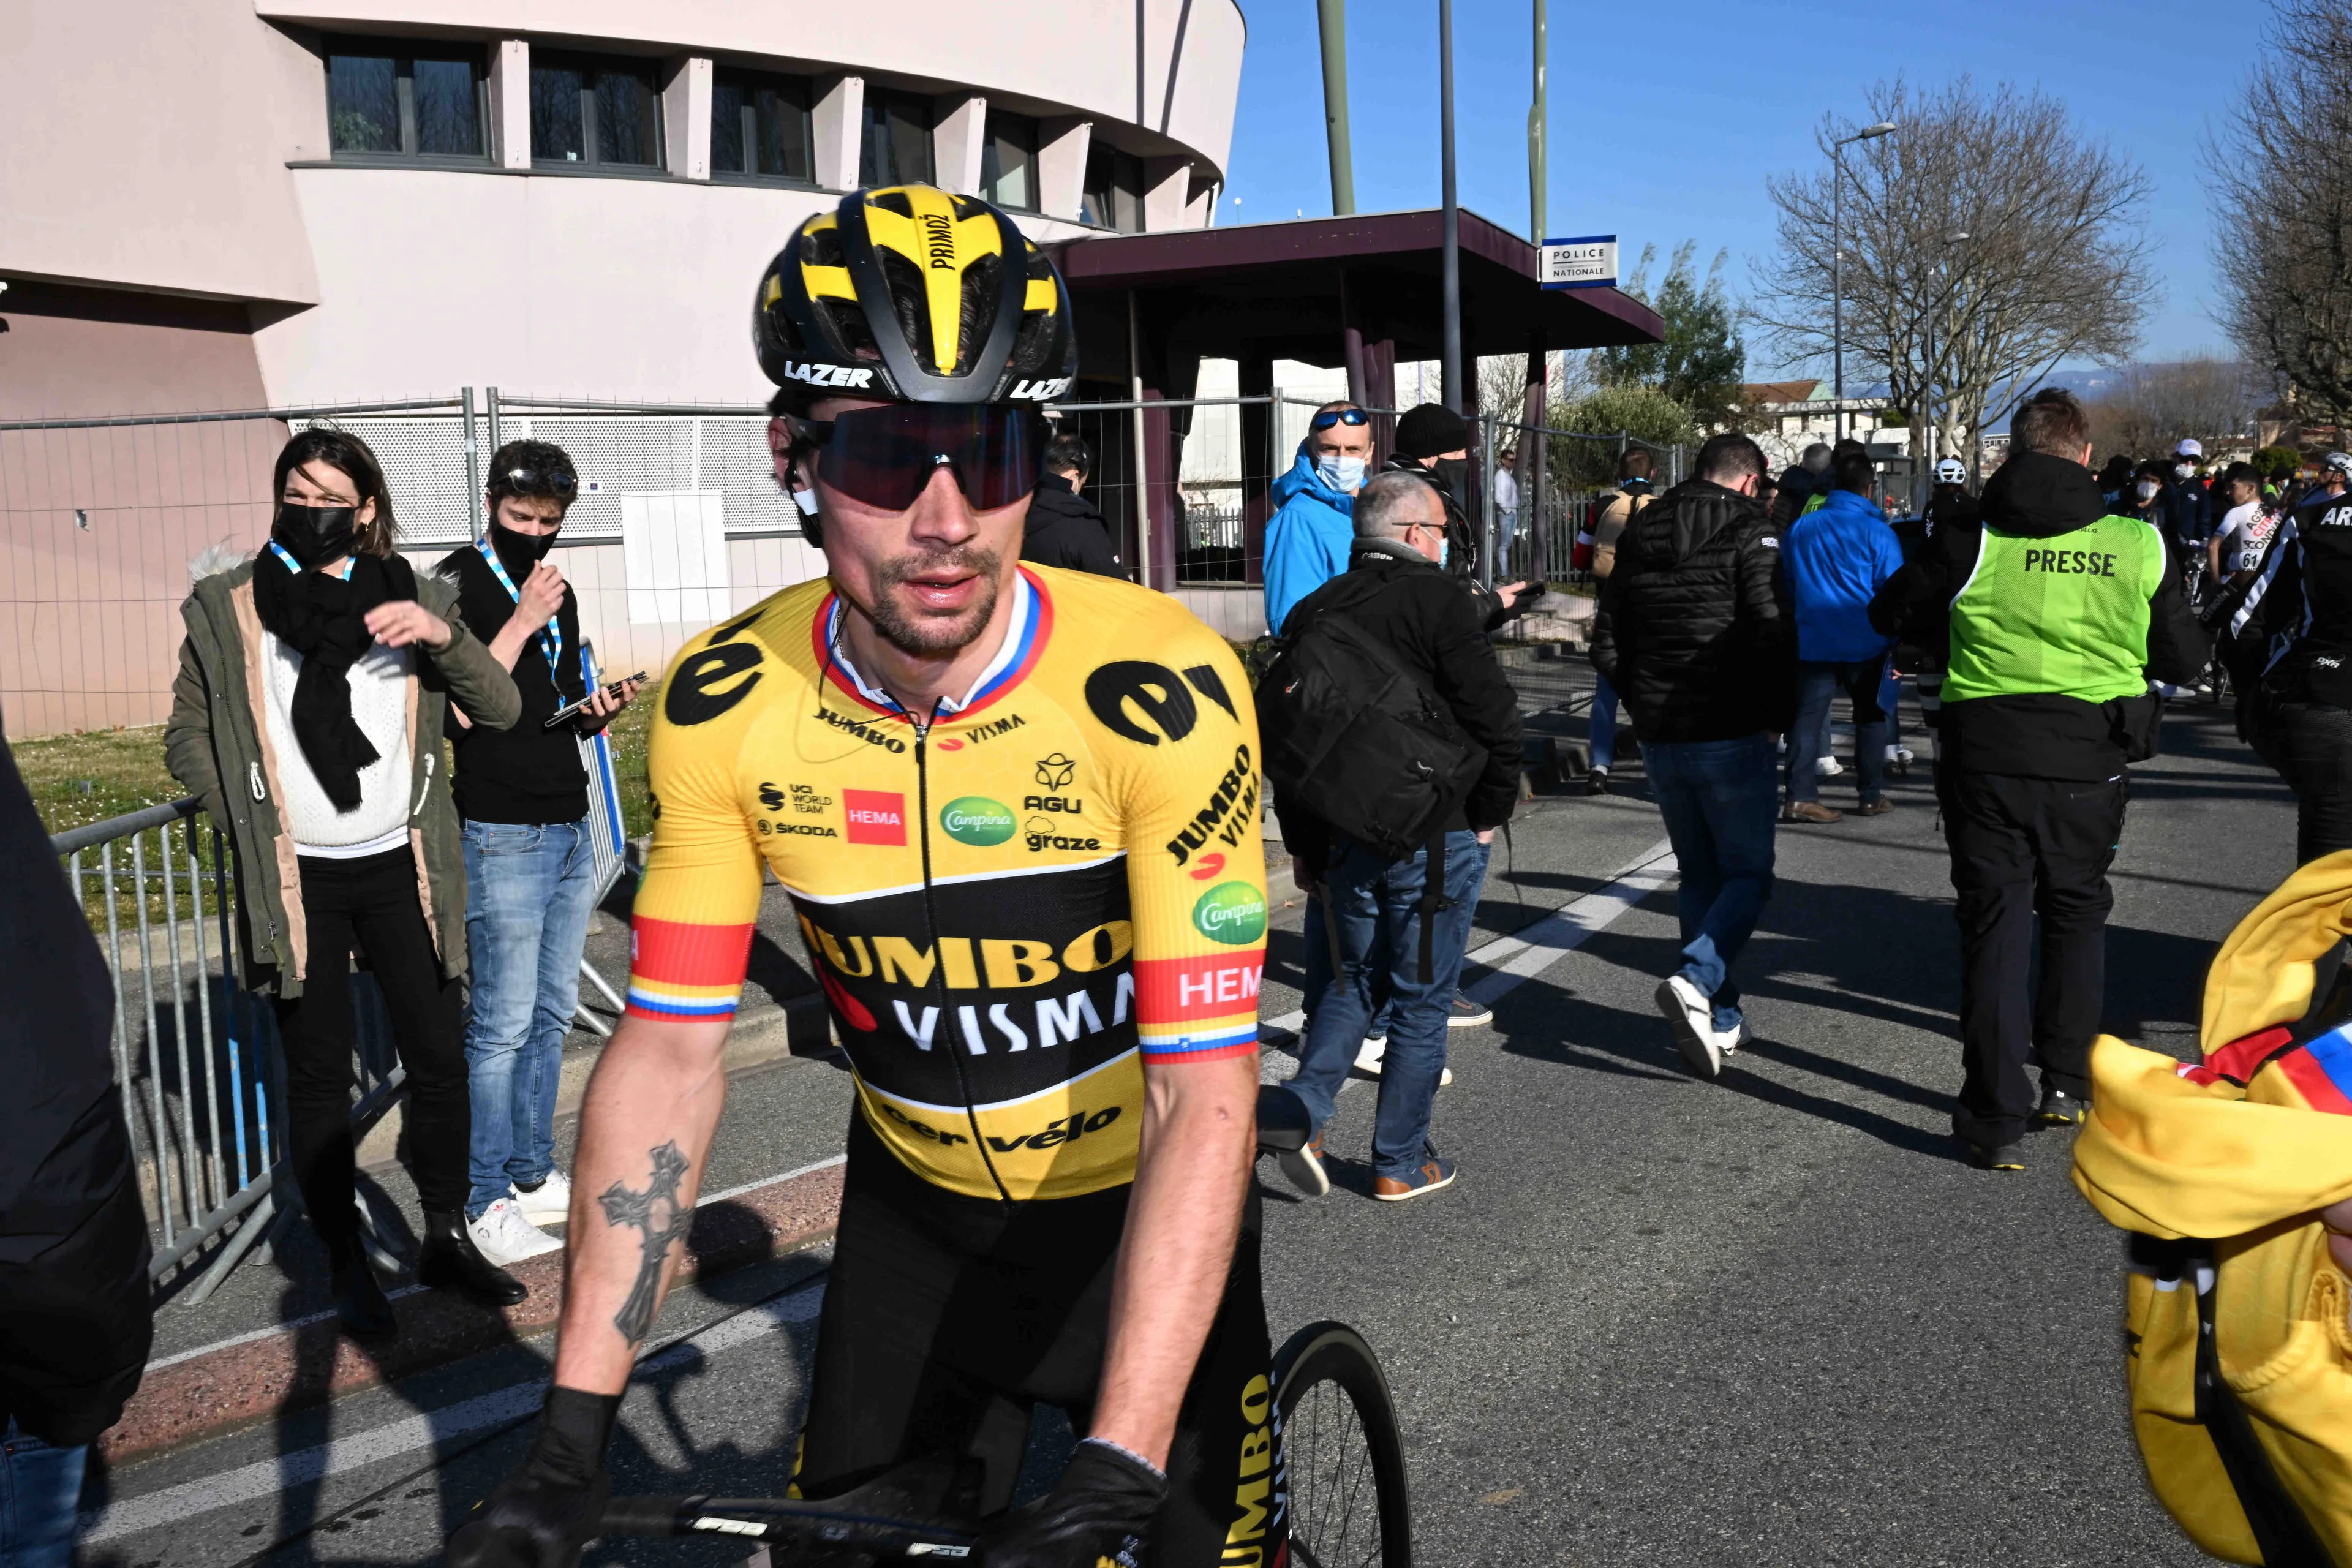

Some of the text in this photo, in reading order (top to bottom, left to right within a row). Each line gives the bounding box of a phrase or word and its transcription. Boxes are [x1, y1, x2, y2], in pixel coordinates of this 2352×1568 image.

[919, 214, 956, 271] PRIMOŽ
[1553, 249, 1604, 259] POLICE
[1553, 268, 1604, 277] NATIONALE
[785, 360, 873, 388] LAZER
[2320, 507, 2352, 526] AR
[2025, 549, 2117, 577] PRESSE
[2243, 553, 2258, 568] 61
[813, 707, 1027, 753] JUMBO VISMA
[790, 784, 813, 794] UCI
[793, 794, 832, 805] WORLD
[1024, 796, 1082, 814] AGU
[1166, 744, 1250, 867] JUMBO
[793, 804, 824, 814] TEAM
[849, 810, 901, 825] HEMA
[775, 822, 839, 837] ŠKODA
[945, 810, 1011, 832] Campina
[1026, 834, 1101, 852] graze
